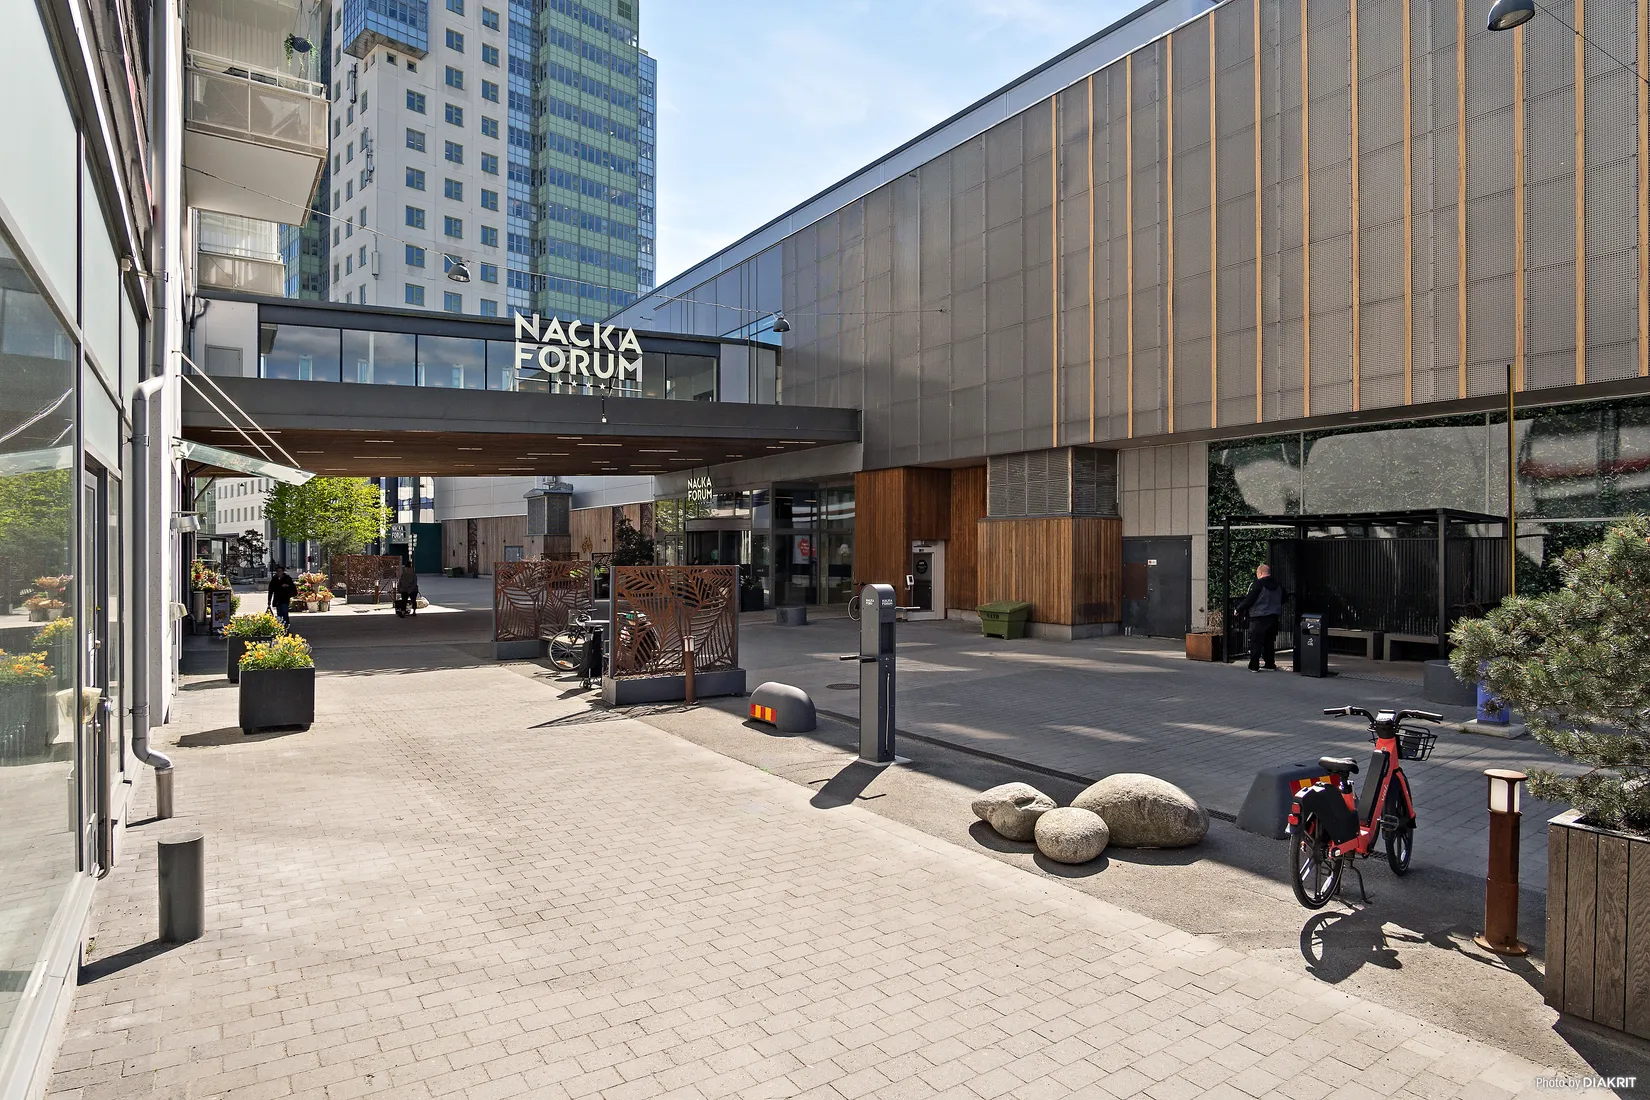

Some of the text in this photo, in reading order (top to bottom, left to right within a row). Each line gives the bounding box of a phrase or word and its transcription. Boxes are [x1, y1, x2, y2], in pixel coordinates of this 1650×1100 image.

[514, 310, 643, 354] NACKA
[515, 341, 643, 382] FORUM
[687, 476, 712, 490] NACKA
[687, 489, 713, 501] FORUM
